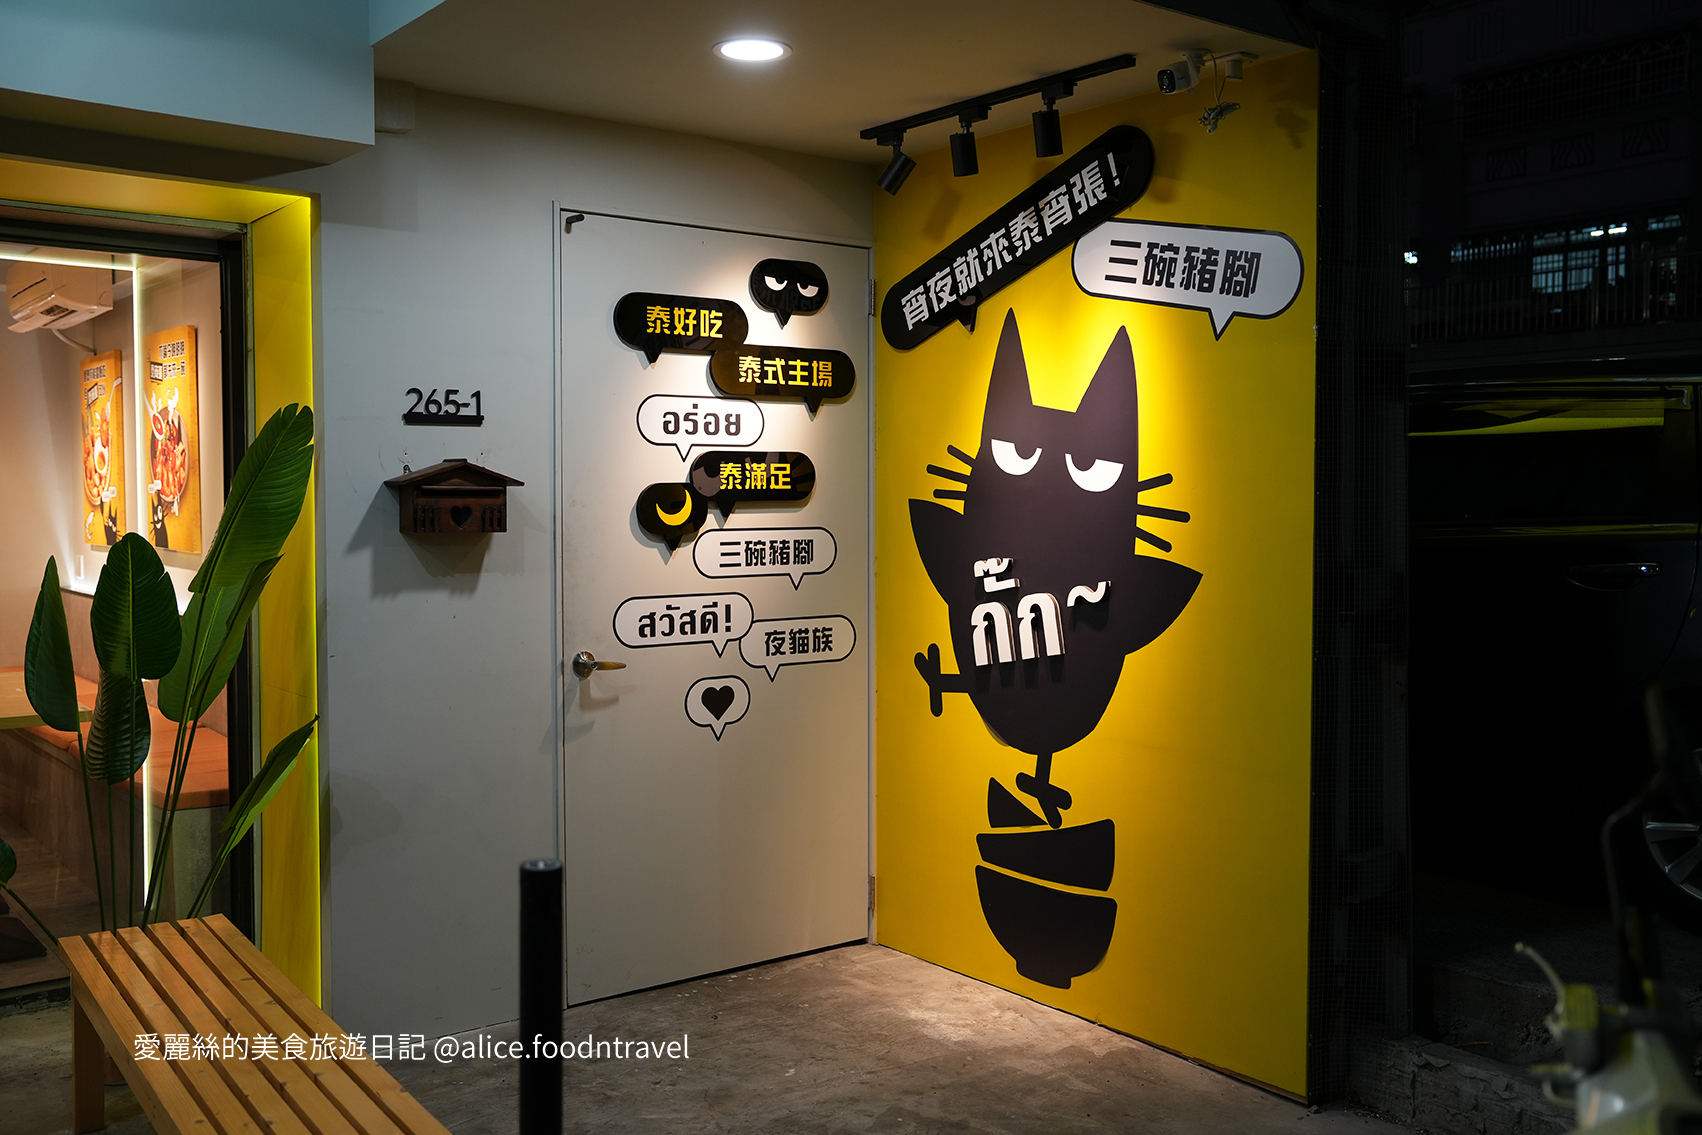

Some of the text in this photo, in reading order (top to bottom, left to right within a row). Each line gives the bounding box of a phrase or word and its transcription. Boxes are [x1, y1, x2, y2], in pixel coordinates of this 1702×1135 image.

[1104, 239, 1262, 298] 三碗豬腳
[646, 305, 723, 338] 泰好吃
[738, 355, 833, 387] 泰式主場
[405, 387, 482, 417] 265-1
[662, 403, 741, 436] อร่อย
[719, 462, 792, 490] 泰滿足
[719, 539, 814, 567] 三碗豬腳
[638, 601, 732, 638] สวัสดี!
[764, 626, 833, 657] 夜貓族
